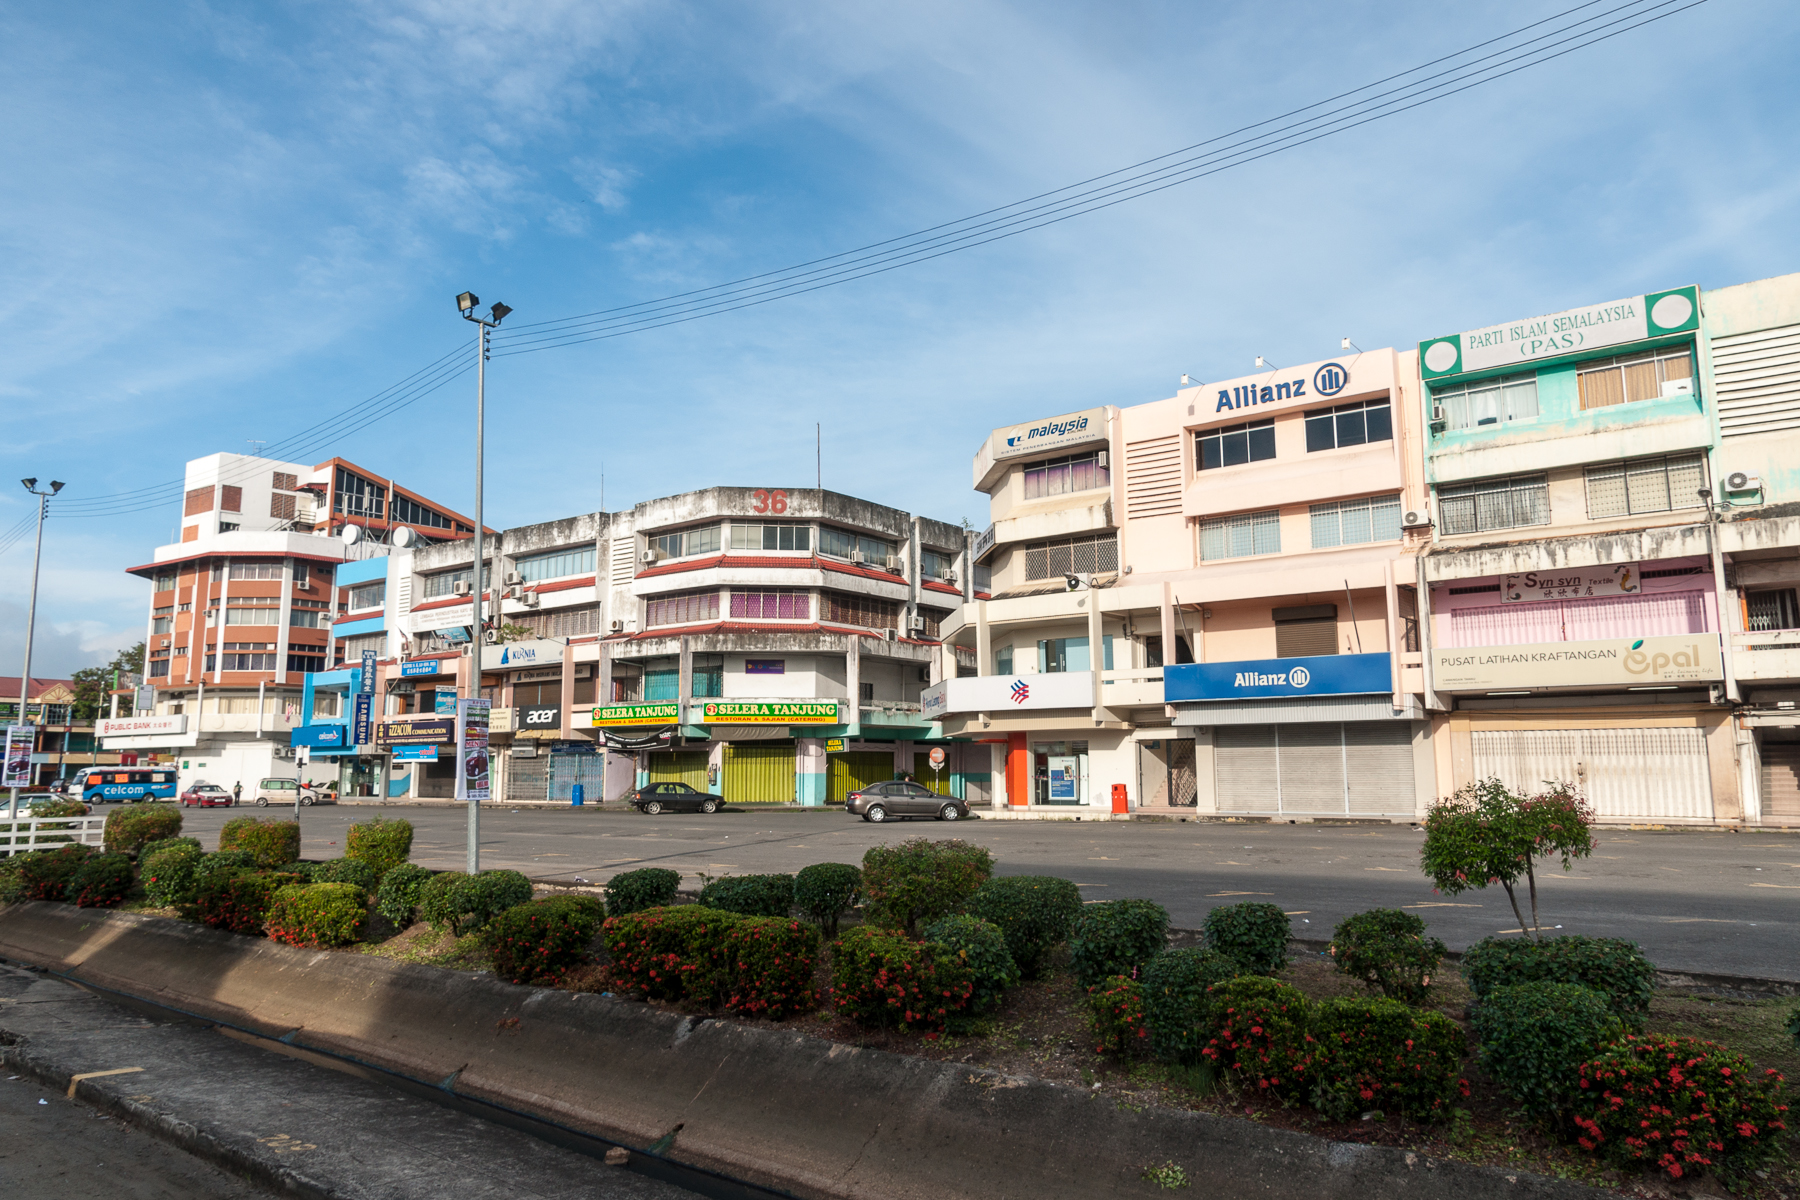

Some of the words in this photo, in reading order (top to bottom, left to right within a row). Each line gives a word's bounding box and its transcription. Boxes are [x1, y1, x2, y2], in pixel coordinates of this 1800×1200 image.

[1469, 330, 1504, 350] PARTI
[1509, 321, 1548, 342] ISLAM
[1553, 304, 1636, 333] SEMALAYSIA
[1520, 331, 1584, 356] (PAS)
[1216, 379, 1306, 413] Allianz
[1027, 416, 1088, 439] malaysia
[1022, 439, 1064, 451] PENERBANGAN
[1066, 433, 1096, 442] MALAYSIA
[753, 489, 788, 514] 36
[1524, 572, 1554, 589] Syn
[1557, 576, 1581, 587] syn
[1588, 578, 1614, 586] Textile
[512, 647, 536, 661] KURNIA
[1441, 656, 1476, 667] PUSAT
[1478, 653, 1529, 665] LATIHAN
[1531, 649, 1617, 662] KRAFTANGAN
[1234, 672, 1287, 687] Allianz
[526, 709, 558, 724] acer
[602, 707, 634, 719] SELERA
[635, 705, 677, 718] TANJUNG
[718, 704, 770, 715] SELERA
[772, 704, 836, 715] TANJUNG
[110, 723, 132, 731] PUBLIC
[133, 721, 151, 730] BANK
[358, 703, 368, 744] SAMSUNG
[104, 785, 144, 795] celcom
